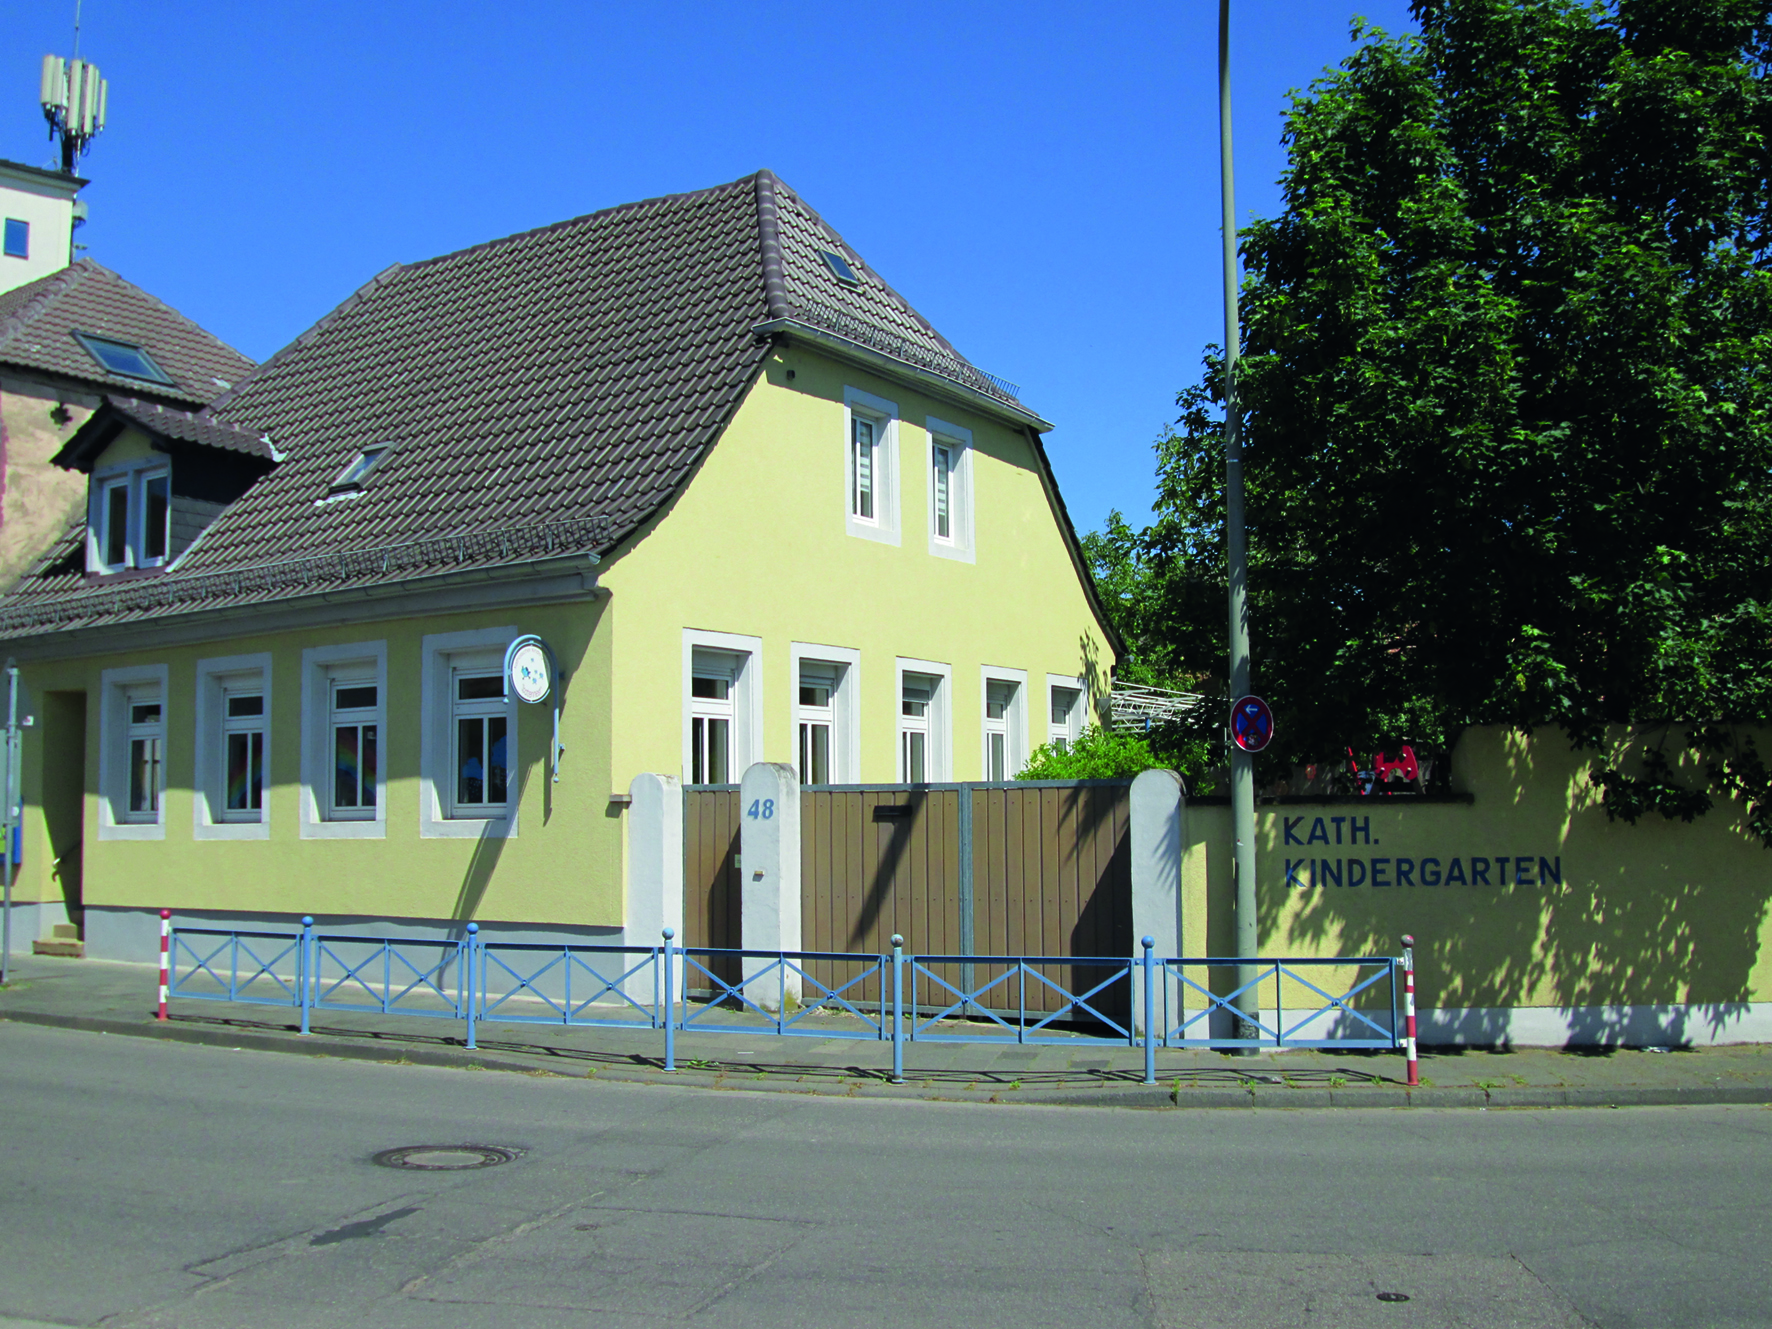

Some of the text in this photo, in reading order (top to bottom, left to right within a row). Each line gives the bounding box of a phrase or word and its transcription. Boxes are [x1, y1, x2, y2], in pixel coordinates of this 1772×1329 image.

[747, 798, 774, 820] 48
[1283, 816, 1380, 845] KATH.
[1284, 856, 1562, 888] KINDERGARTEN
